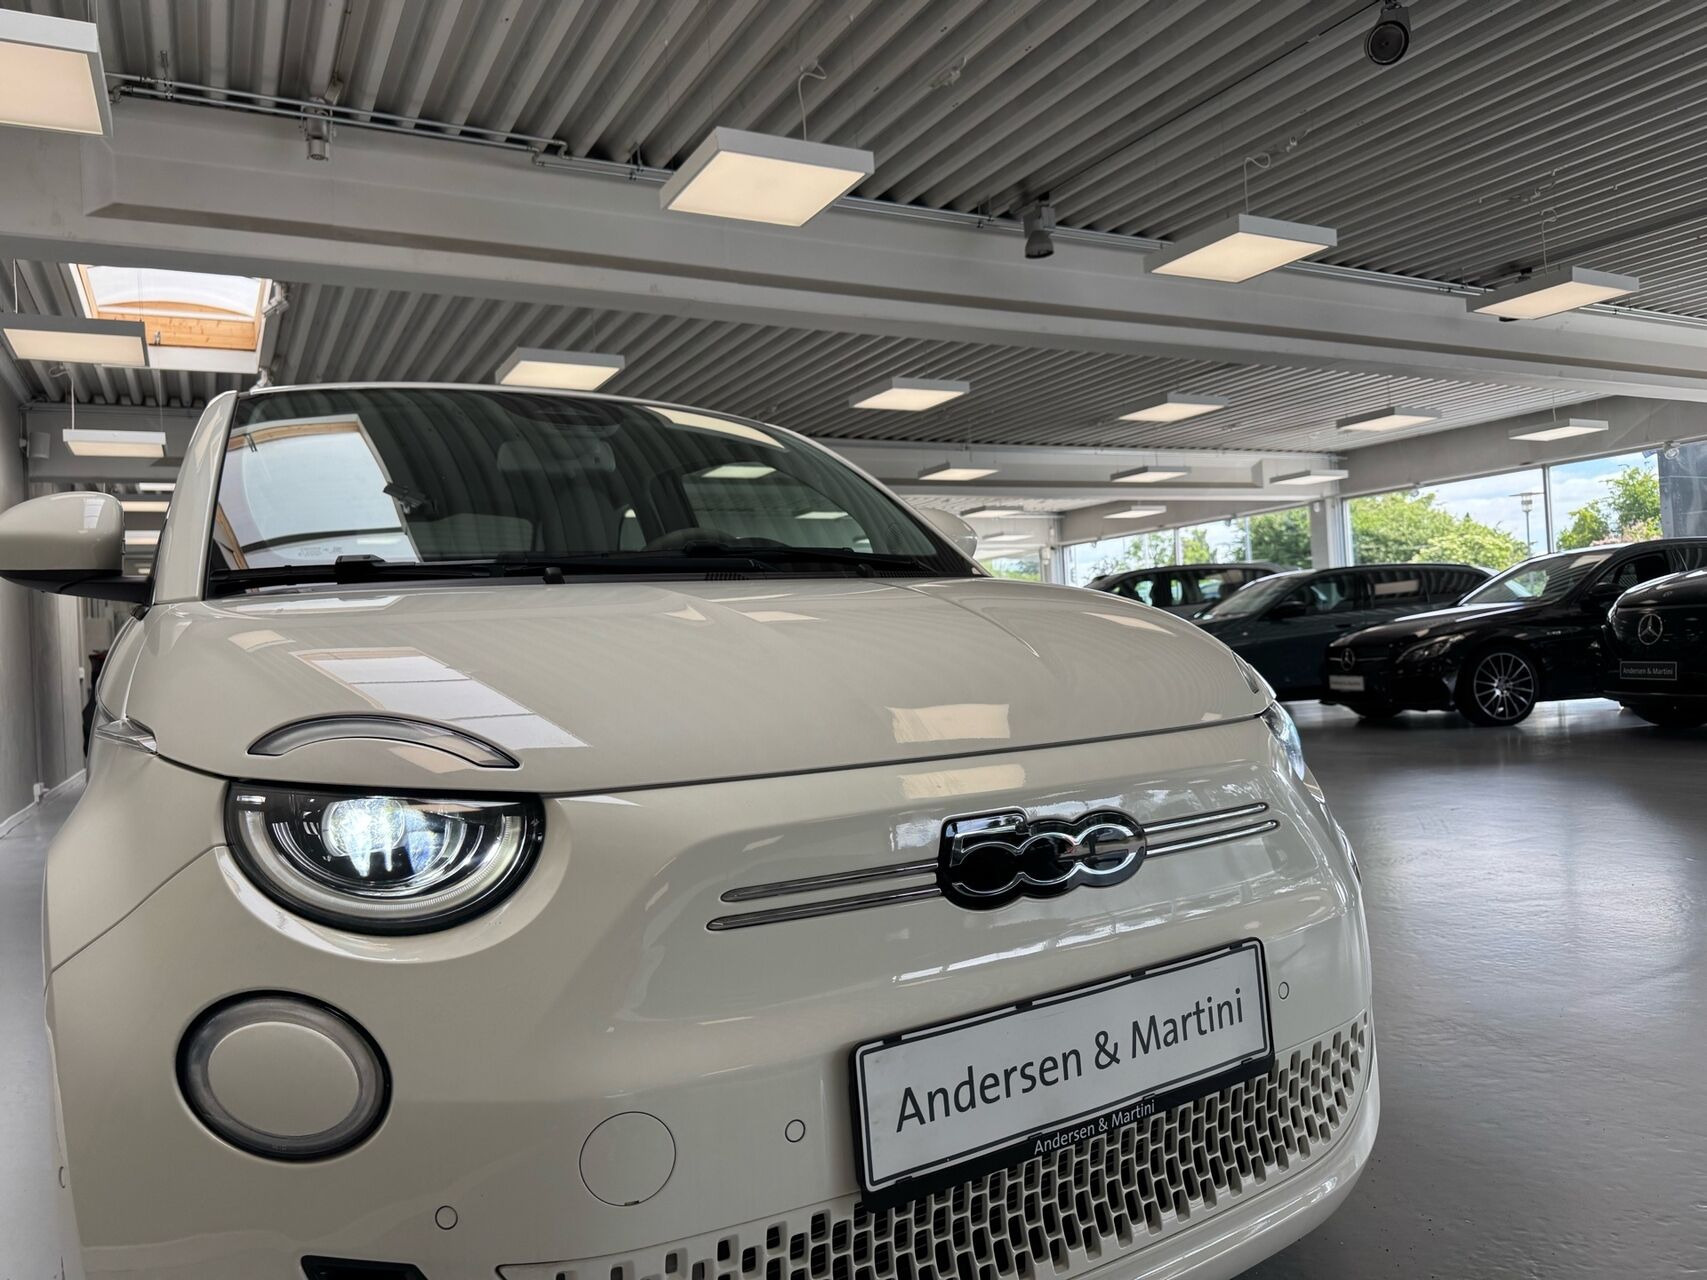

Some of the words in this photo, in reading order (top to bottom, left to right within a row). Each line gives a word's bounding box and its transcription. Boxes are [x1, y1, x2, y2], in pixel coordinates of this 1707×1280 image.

[896, 1048, 1082, 1133] Andersen
[1094, 1030, 1121, 1070] &
[1131, 987, 1243, 1059] Martini
[1034, 1124, 1095, 1155] Andersen
[1098, 1117, 1109, 1132] &
[1111, 1100, 1155, 1128] Martini
